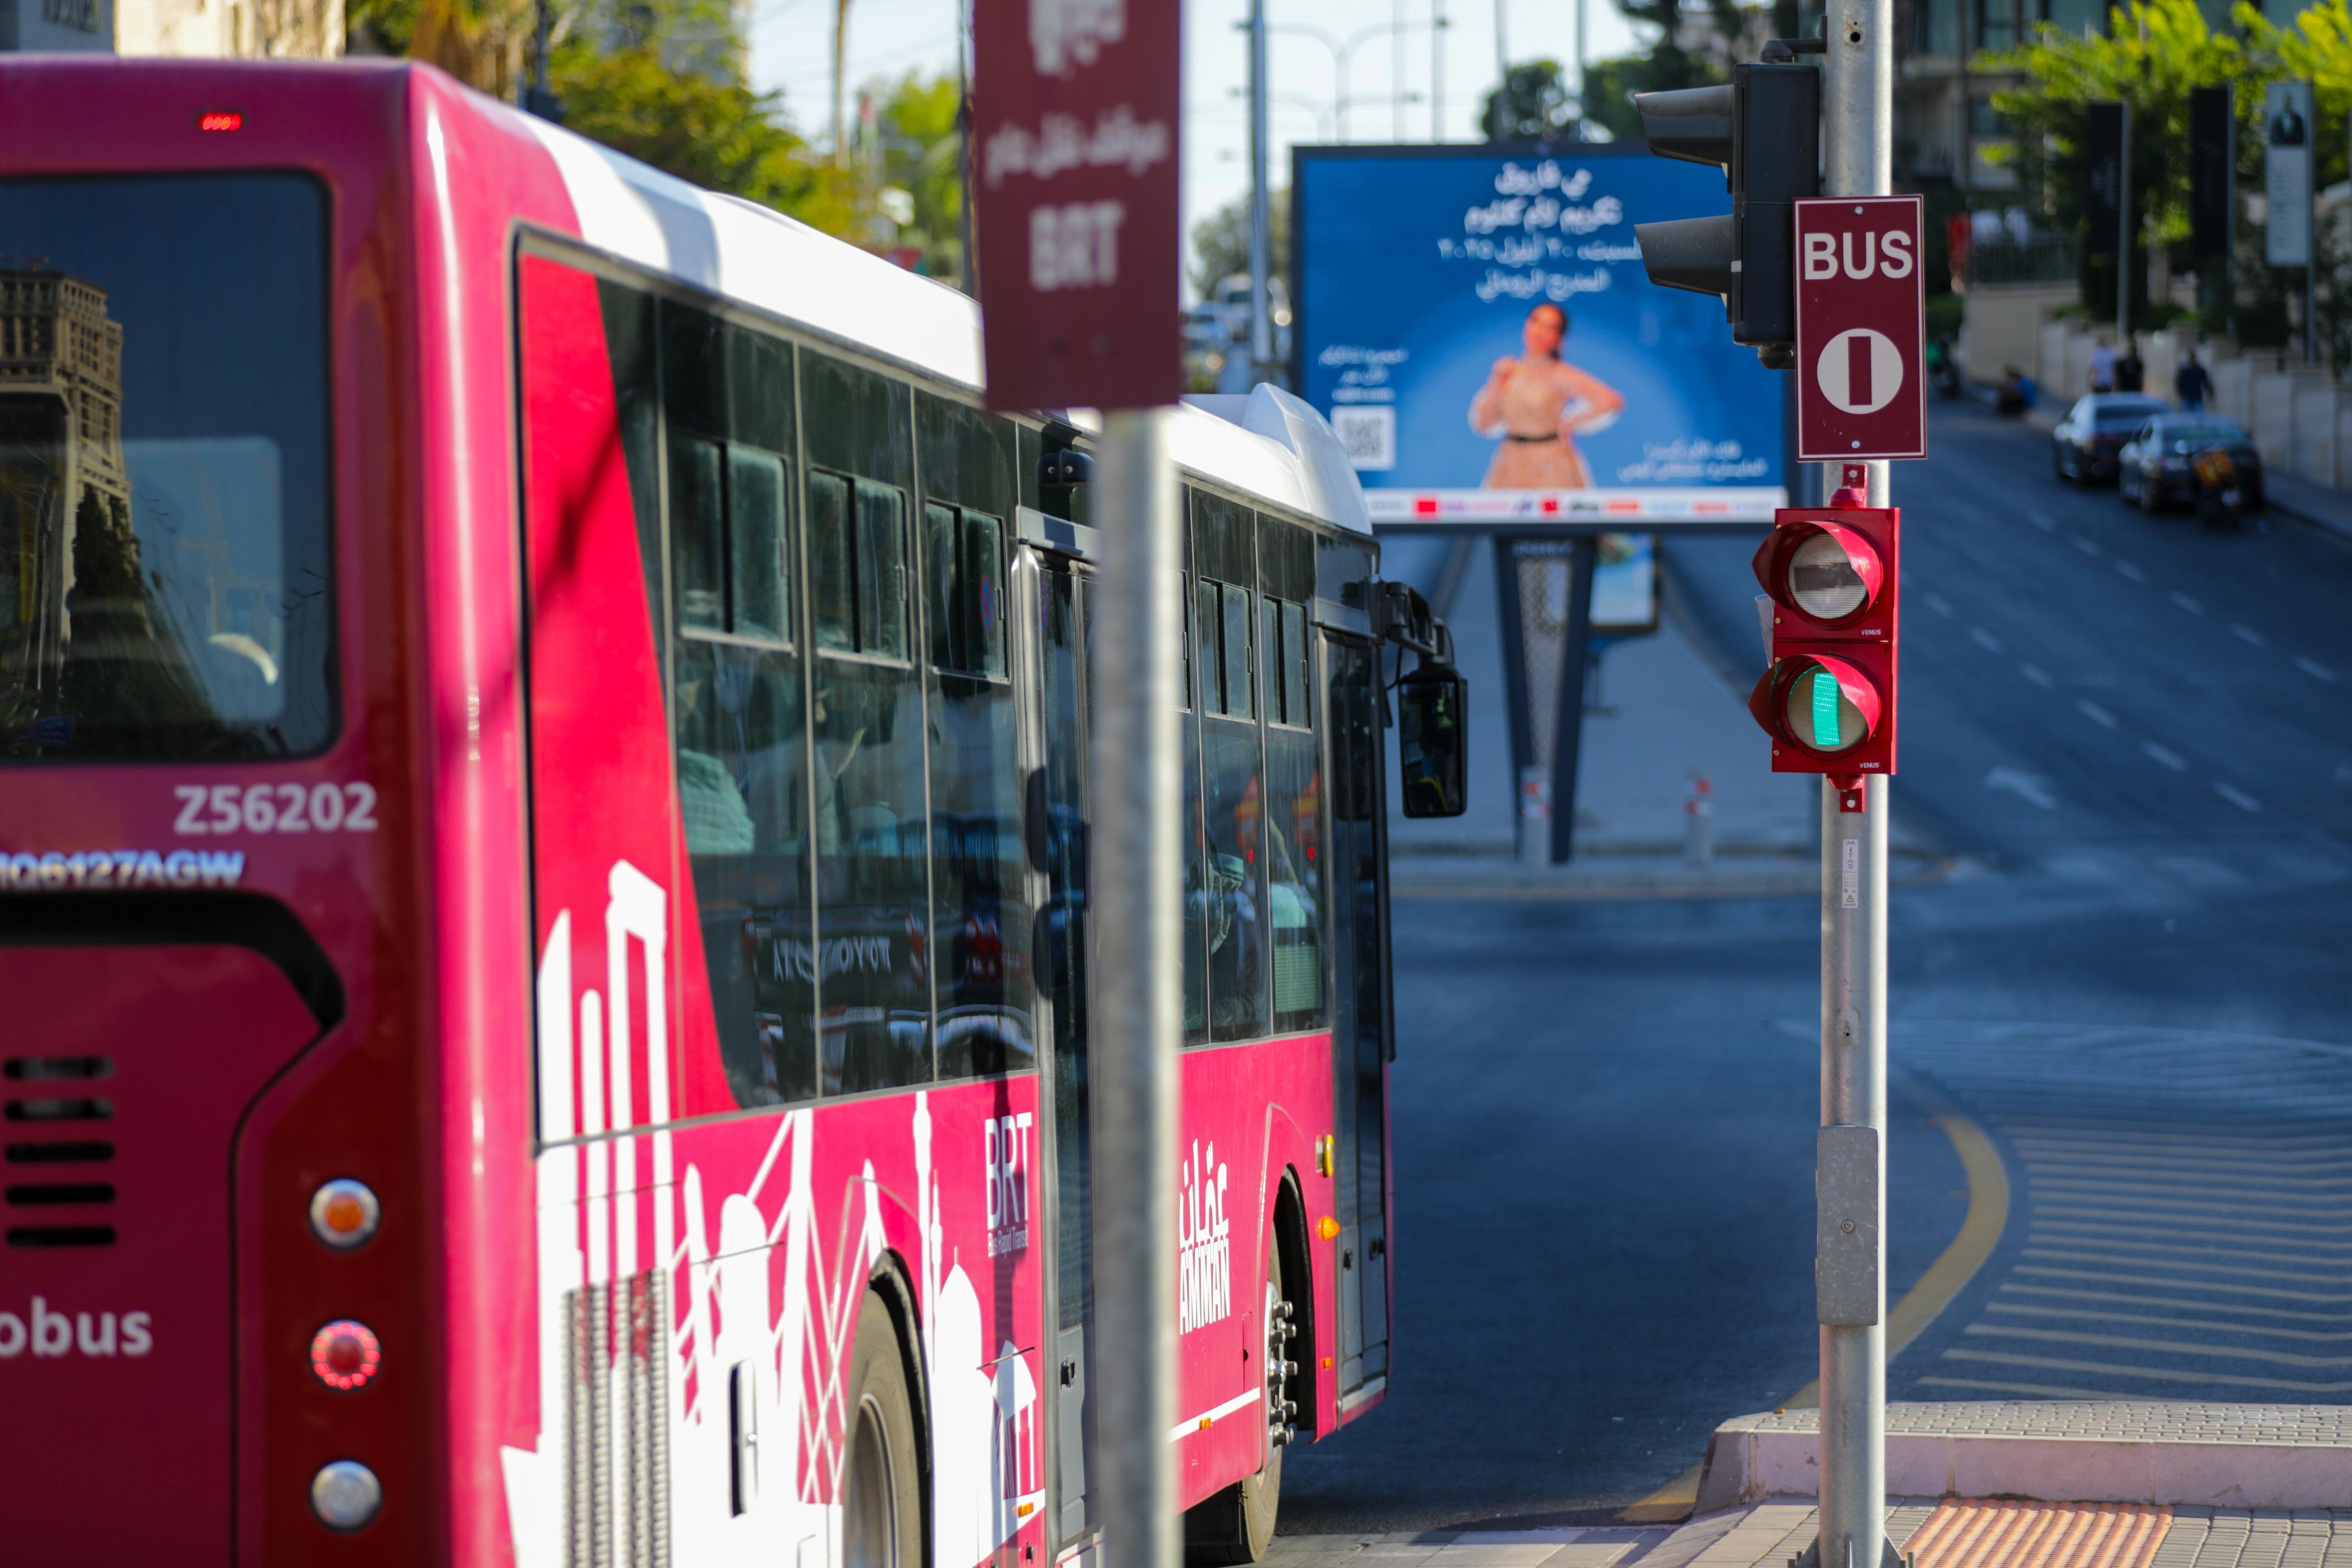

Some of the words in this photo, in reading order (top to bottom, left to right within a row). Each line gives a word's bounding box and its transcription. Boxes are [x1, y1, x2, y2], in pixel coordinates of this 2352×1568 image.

[1804, 231, 1913, 280] BUS
[174, 782, 378, 834] Z56202
[985, 1112, 1032, 1230] BRT
[988, 1232, 998, 1257] Bus
[998, 1226, 1011, 1258] Rapid
[1012, 1223, 1028, 1250] Transit
[1180, 1238, 1230, 1336] AMMAN
